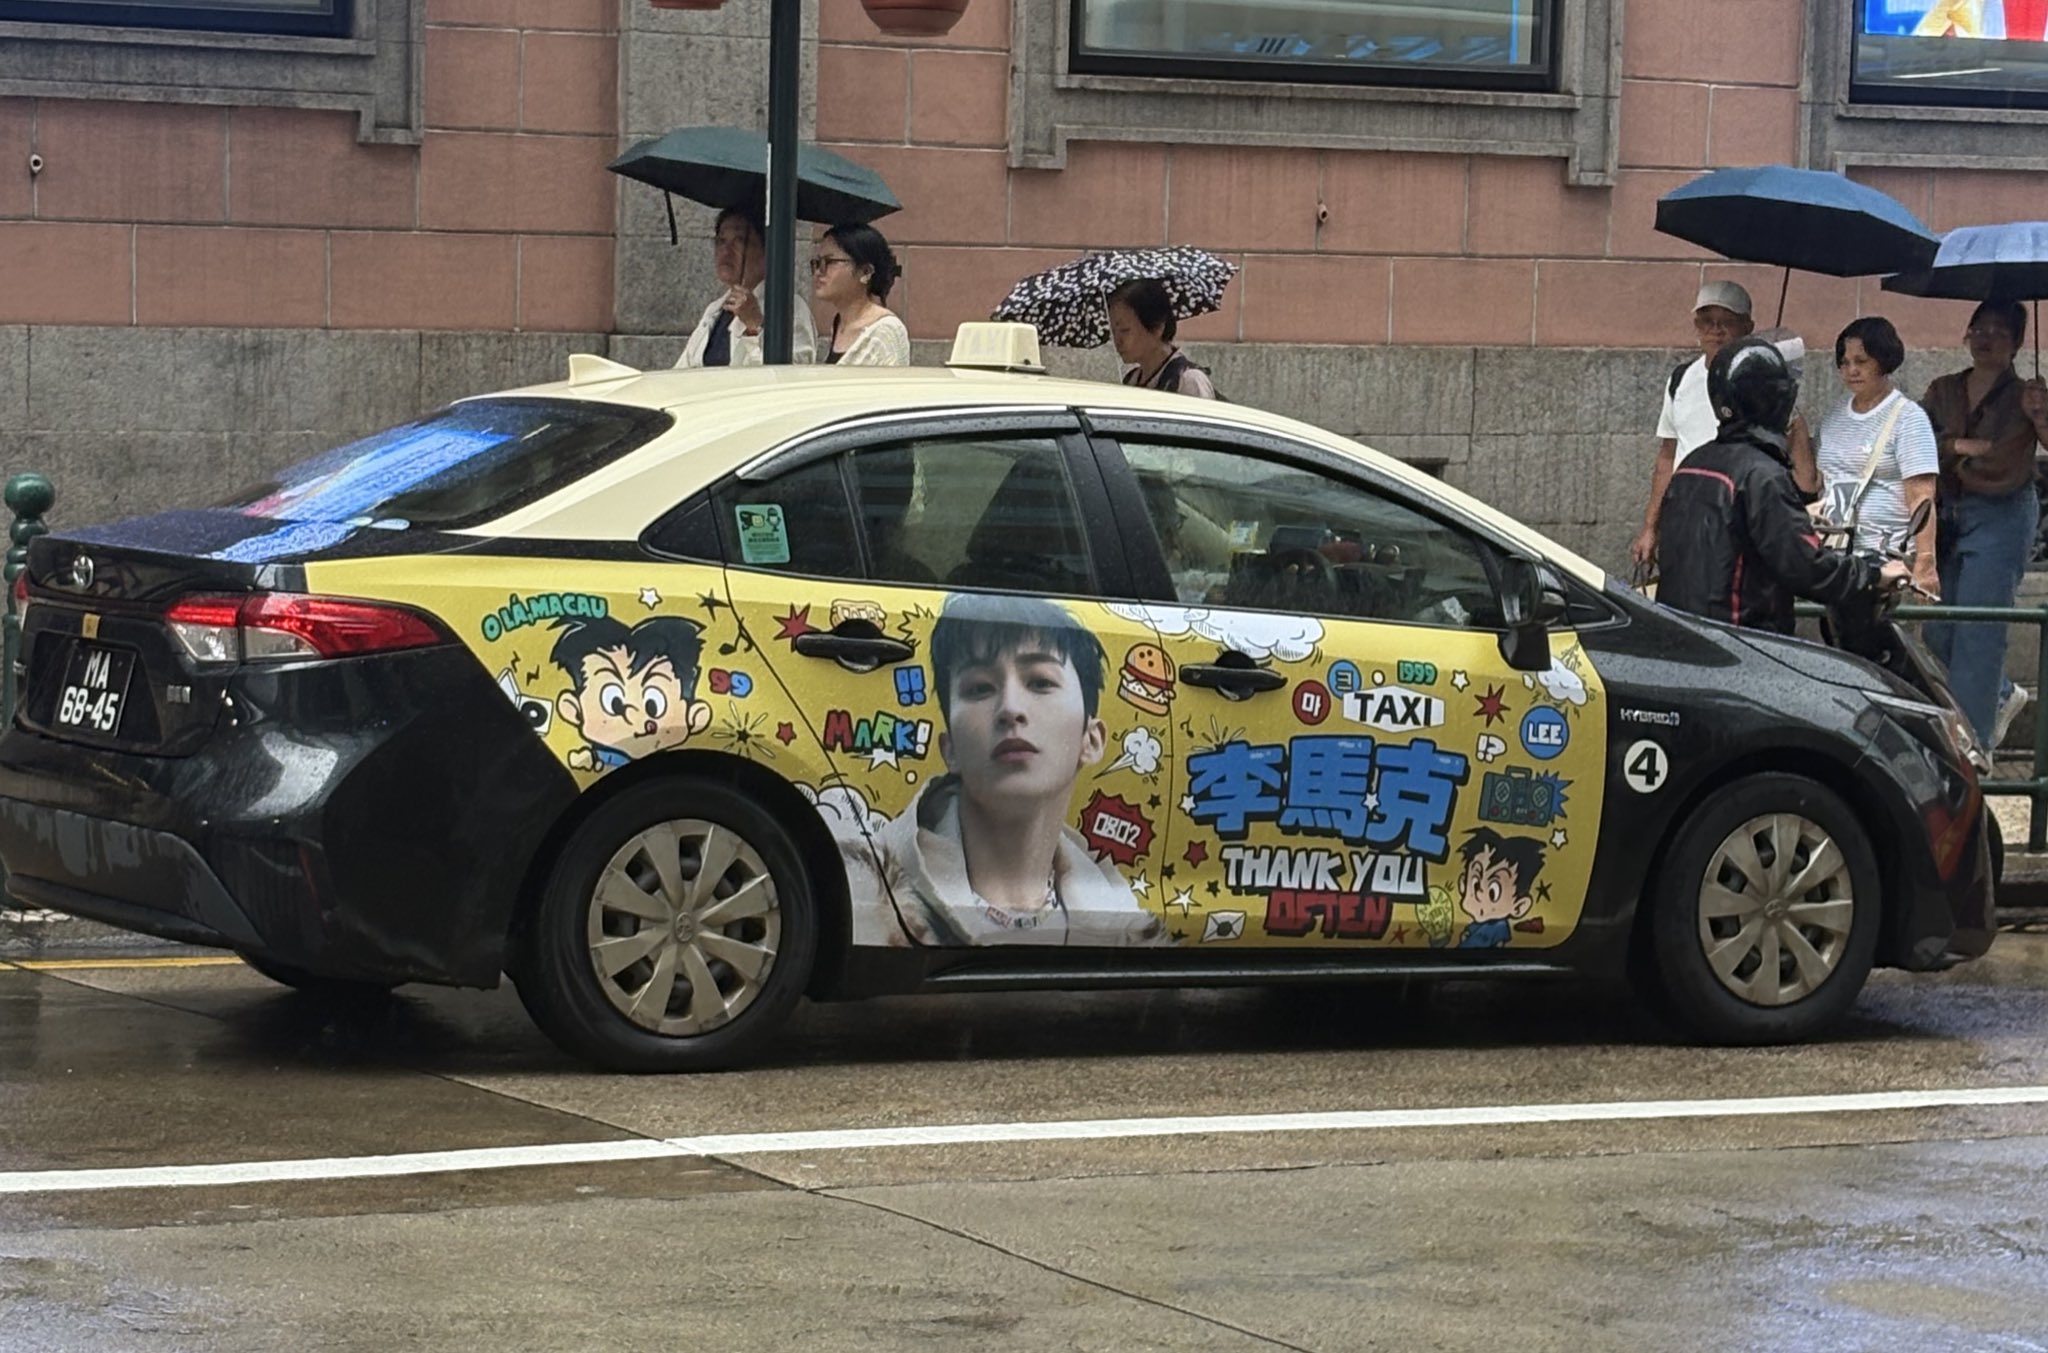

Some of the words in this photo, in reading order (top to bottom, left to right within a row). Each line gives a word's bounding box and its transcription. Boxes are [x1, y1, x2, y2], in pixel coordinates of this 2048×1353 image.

[84, 651, 111, 689] MA
[1398, 660, 1437, 685] 1999
[59, 686, 119, 731] 68-45
[1354, 693, 1432, 727] TAXI
[825, 710, 932, 758] MARK!
[1527, 721, 1563, 746] LEE
[1628, 746, 1661, 786] 4
[1188, 737, 1468, 858] 李馬克
[1221, 846, 1344, 892] THANK
[1351, 852, 1428, 897] YOU
[1264, 891, 1390, 934] OFTEN
